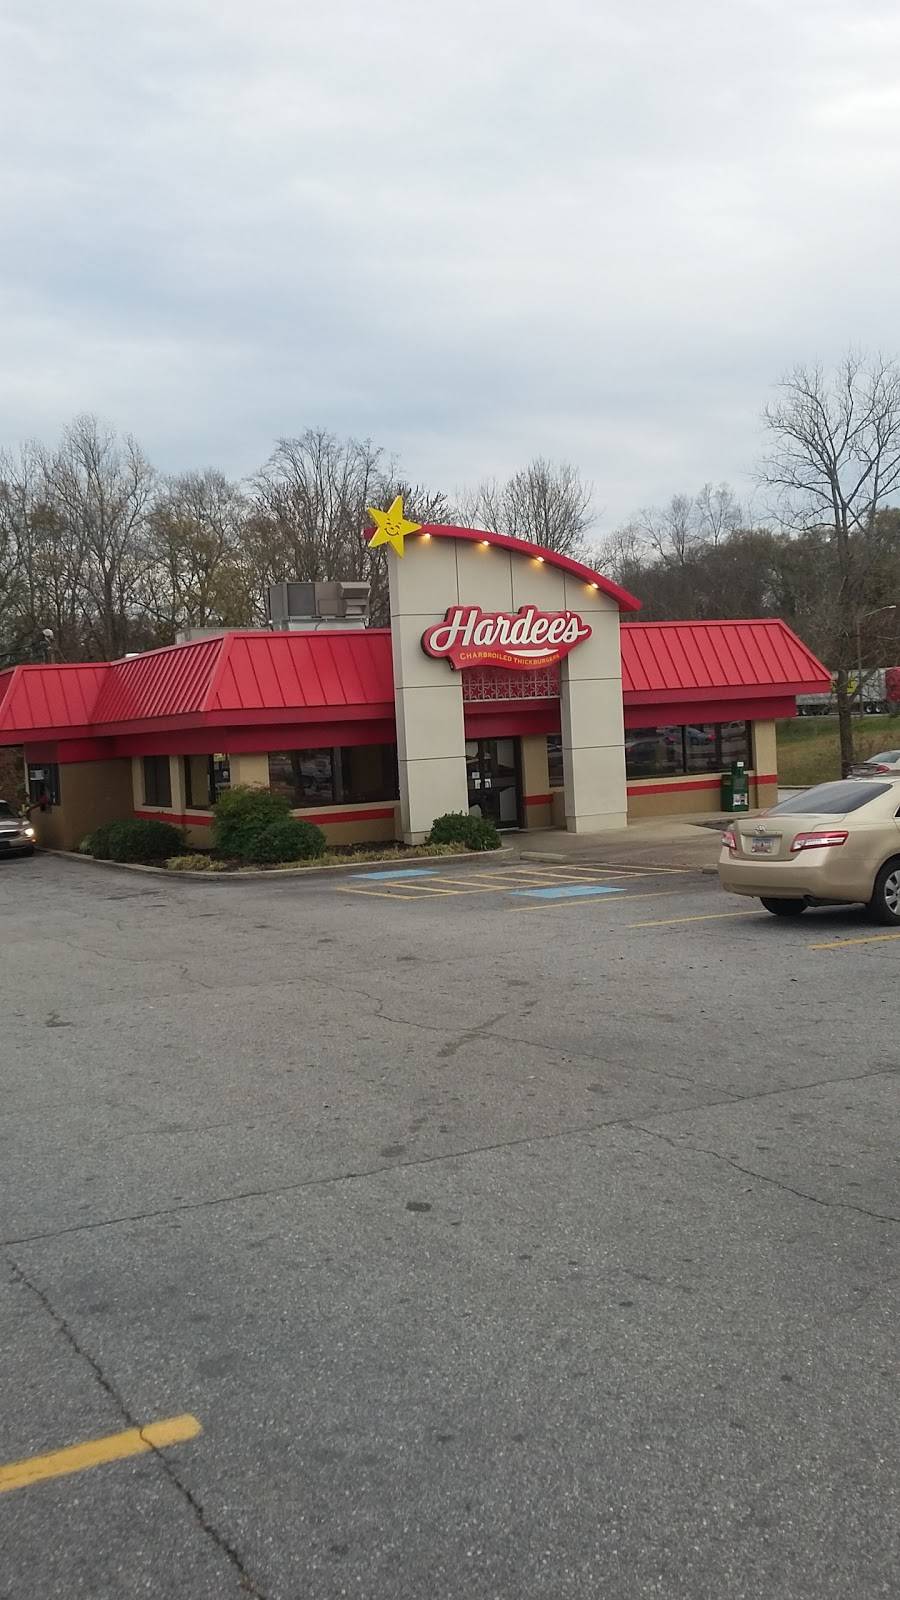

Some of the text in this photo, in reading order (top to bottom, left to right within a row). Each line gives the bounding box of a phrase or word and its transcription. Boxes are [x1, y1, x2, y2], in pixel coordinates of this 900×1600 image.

[430, 609, 588, 652] Hardee's
[459, 652, 560, 665] CHARBROILED THICKBURGERS
